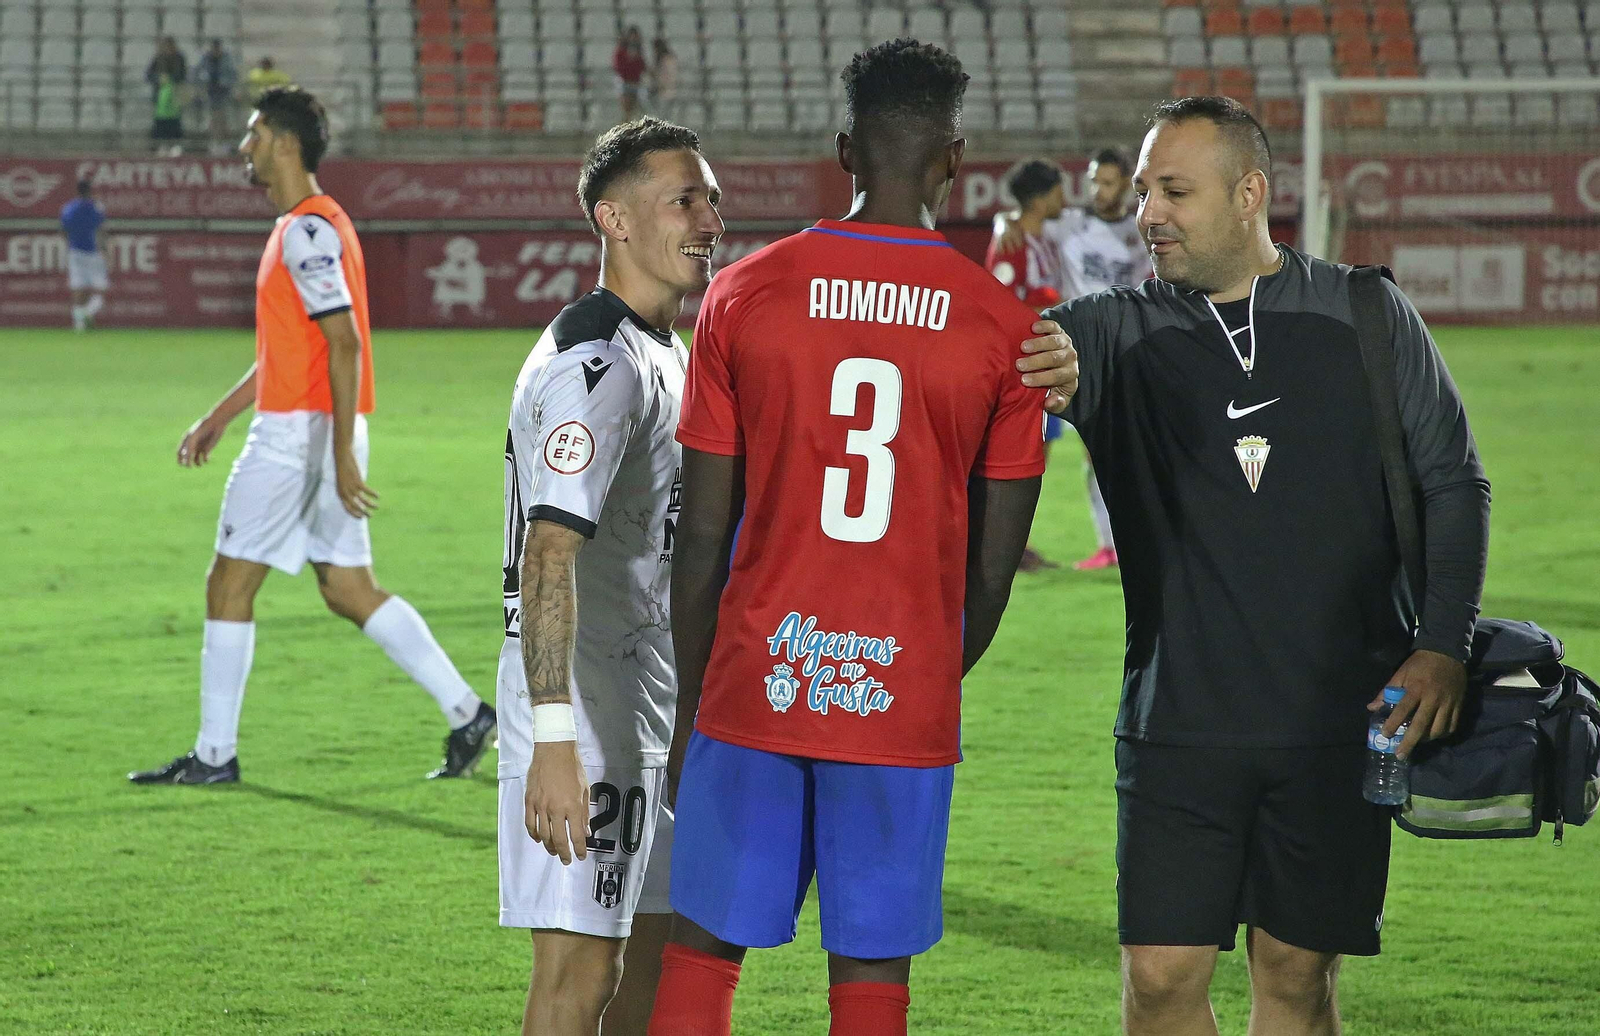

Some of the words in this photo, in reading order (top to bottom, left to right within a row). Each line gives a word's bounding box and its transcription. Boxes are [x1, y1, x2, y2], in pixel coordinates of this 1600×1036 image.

[809, 277, 951, 331] ADMONIO
[820, 357, 903, 543] 3
[766, 611, 903, 677] Algeciras
[839, 662, 867, 682] me
[807, 665, 894, 717] Gusta
[586, 781, 647, 856] 20
